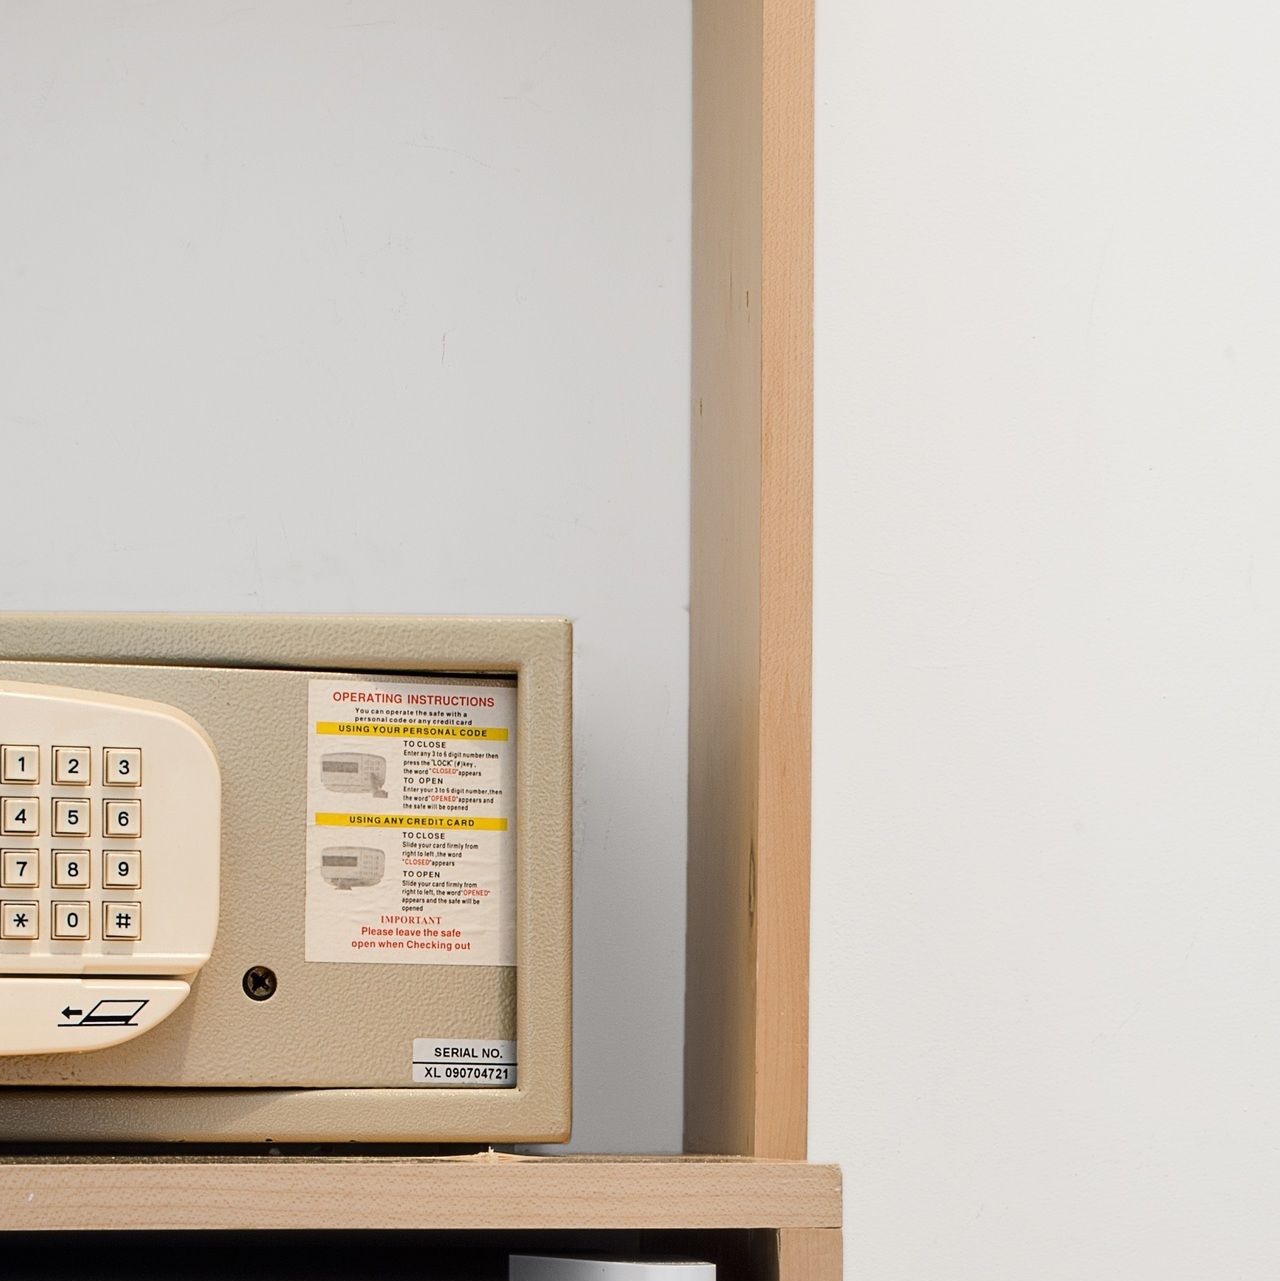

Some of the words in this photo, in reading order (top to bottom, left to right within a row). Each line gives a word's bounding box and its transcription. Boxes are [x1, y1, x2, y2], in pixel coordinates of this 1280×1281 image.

[333, 692, 402, 704] OPERATING
[407, 695, 495, 707] INSTRUCTIONS
[339, 725, 370, 733] USING
[403, 727, 457, 736] PERSONAL
[460, 729, 487, 737] CODE
[18, 757, 25, 772] 1
[68, 759, 79, 774] 2
[119, 760, 129, 774] 3
[15, 809, 27, 824] 4
[68, 810, 79, 825] 5
[118, 812, 129, 826] 6
[350, 816, 381, 824] USING
[384, 817, 403, 825] ANY
[407, 818, 444, 826] CREDIT
[447, 819, 475, 827] CARD
[416, 832, 445, 840] CLOSE
[447, 843, 464, 851] firmly
[16, 861, 27, 876] 7
[68, 862, 79, 877] 8
[118, 862, 129, 876] 9
[446, 881, 462, 889] firmly
[68, 913, 78, 927] 0
[116, 913, 131, 928] #
[381, 916, 442, 925] IMPORTANT
[361, 927, 393, 936] Please
[396, 927, 420, 937] leave
[423, 928, 438, 937] the
[441, 928, 461, 937] safe
[378, 940, 404, 948] when
[407, 941, 452, 951] Checking
[455, 942, 471, 950] out
[435, 1048, 478, 1058] SERIAL
[482, 1049, 503, 1058] NO.
[425, 1067, 441, 1078] XL
[445, 1068, 508, 1079] 090704721
